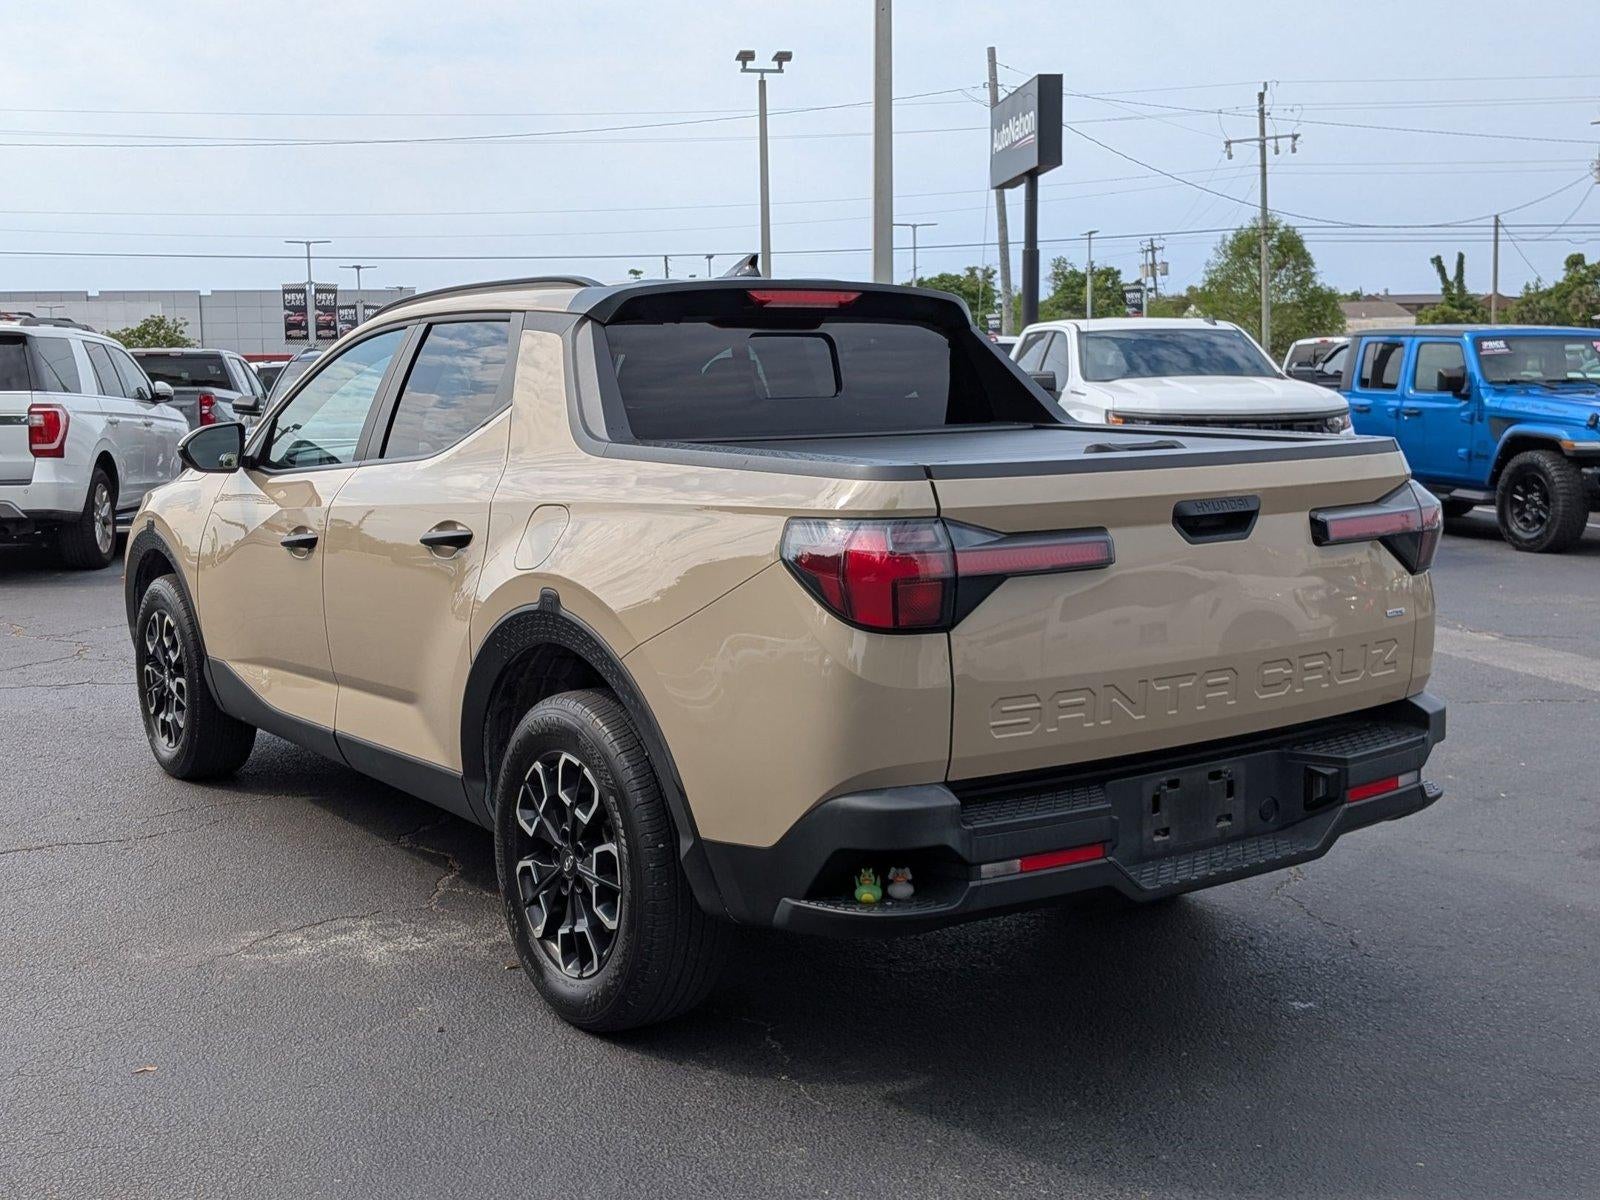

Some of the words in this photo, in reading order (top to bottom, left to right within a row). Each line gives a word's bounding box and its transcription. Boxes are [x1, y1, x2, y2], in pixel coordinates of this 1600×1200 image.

[284, 292, 305, 300] NEW
[315, 292, 336, 300] NEW
[1193, 498, 1250, 513] HYUNDAI
[988, 666, 1239, 739] SANTA
[1254, 637, 1399, 699] CRUZ
